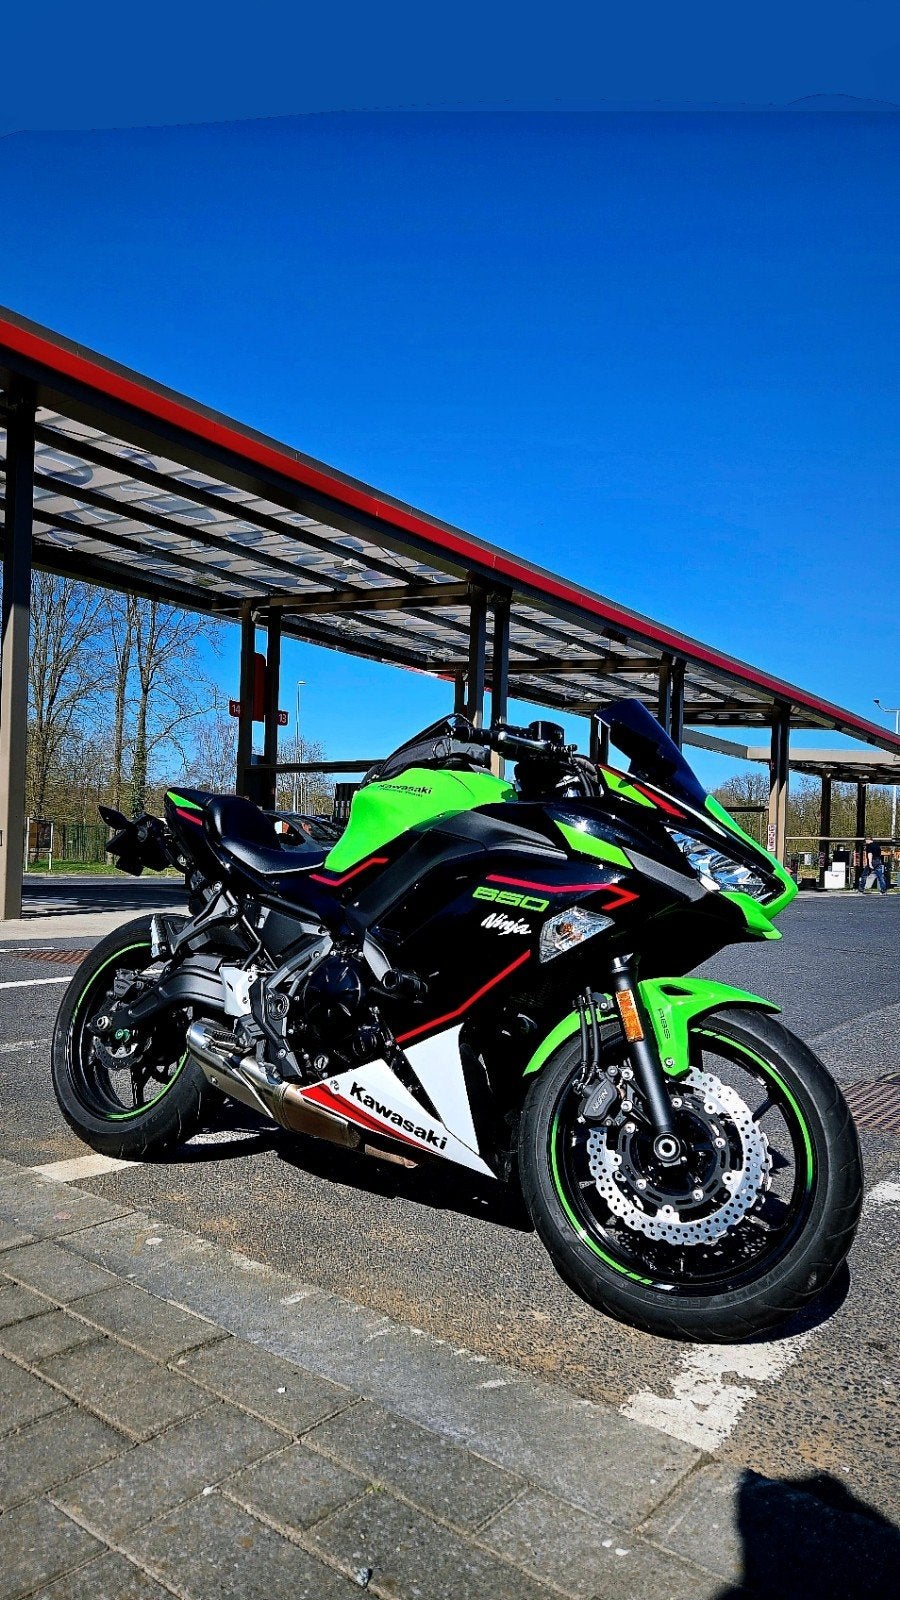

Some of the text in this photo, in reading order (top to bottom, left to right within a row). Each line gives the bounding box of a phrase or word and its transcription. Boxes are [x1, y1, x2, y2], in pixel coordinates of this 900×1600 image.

[378, 784, 433, 794] Kawasaki
[472, 886, 550, 912] 650
[481, 912, 532, 935] Ninja
[349, 1081, 448, 1150] Kawasaki
